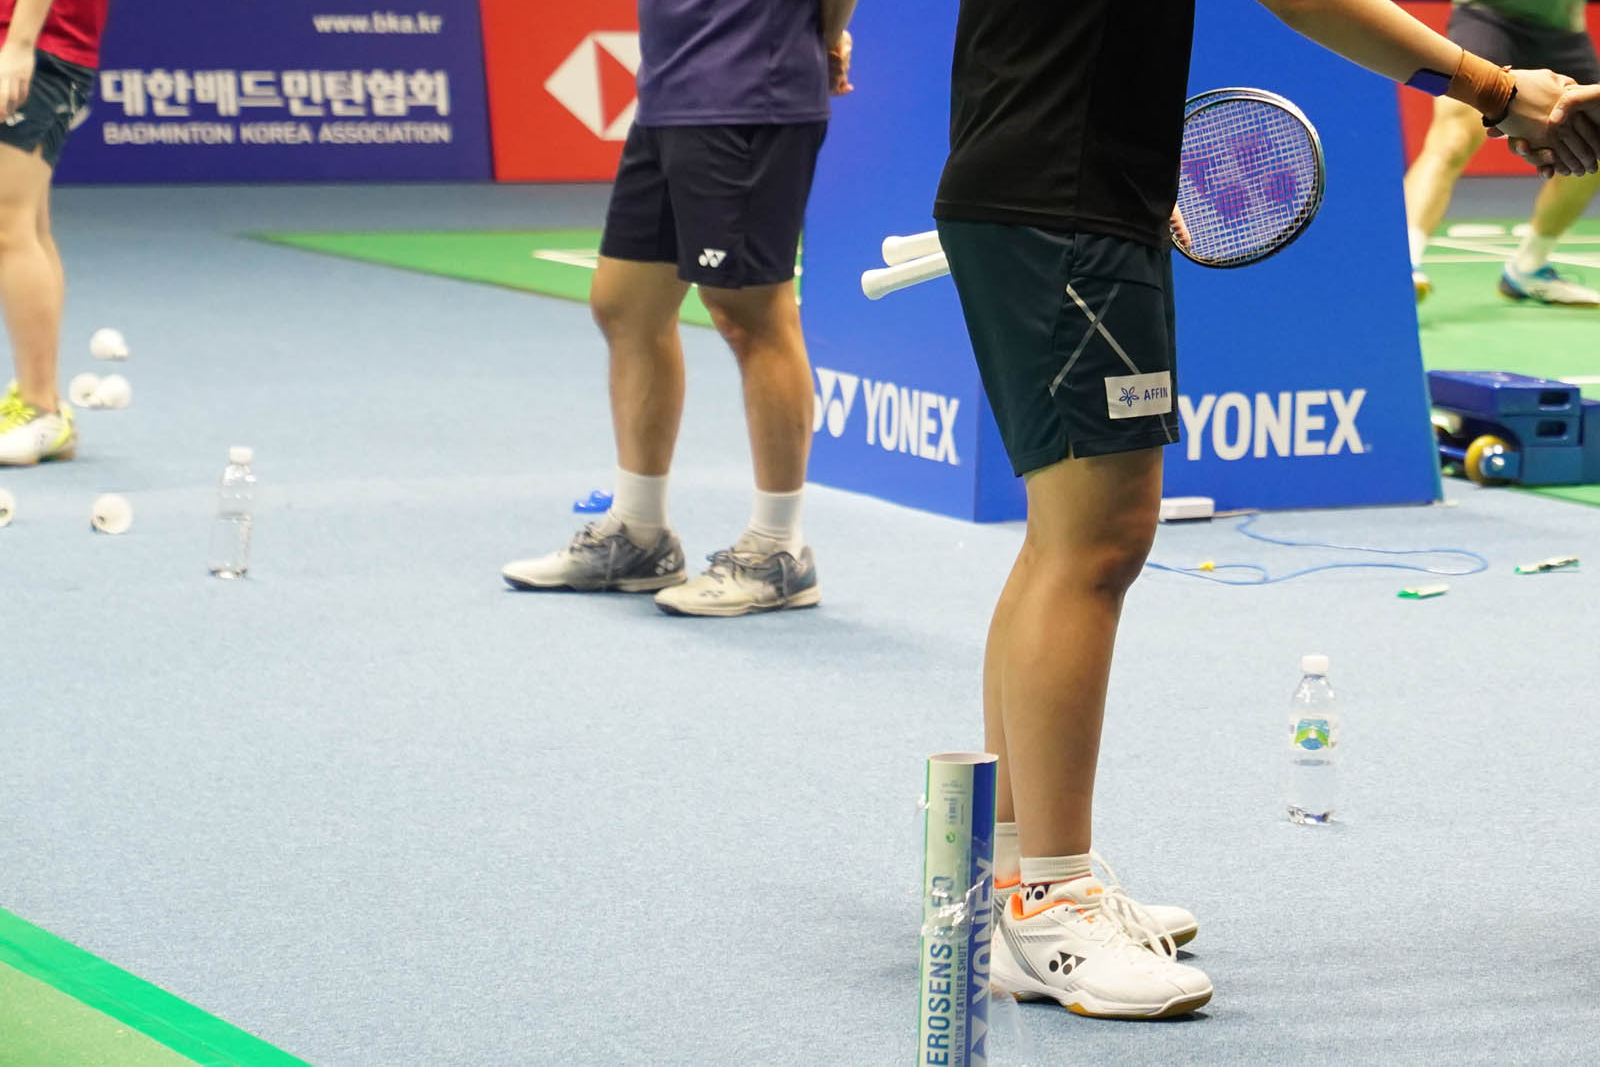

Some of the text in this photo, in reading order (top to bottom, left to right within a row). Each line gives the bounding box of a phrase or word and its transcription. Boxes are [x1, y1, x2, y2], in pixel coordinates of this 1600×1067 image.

[312, 11, 443, 34] www.bka.kr
[101, 69, 450, 117] 대한배드민턴협회
[103, 121, 452, 145] BADMINTON KOREA ASSOCIATION
[1143, 386, 1169, 401] AFFIN
[862, 377, 961, 466] YONEX
[1177, 388, 1368, 462] YONEX
